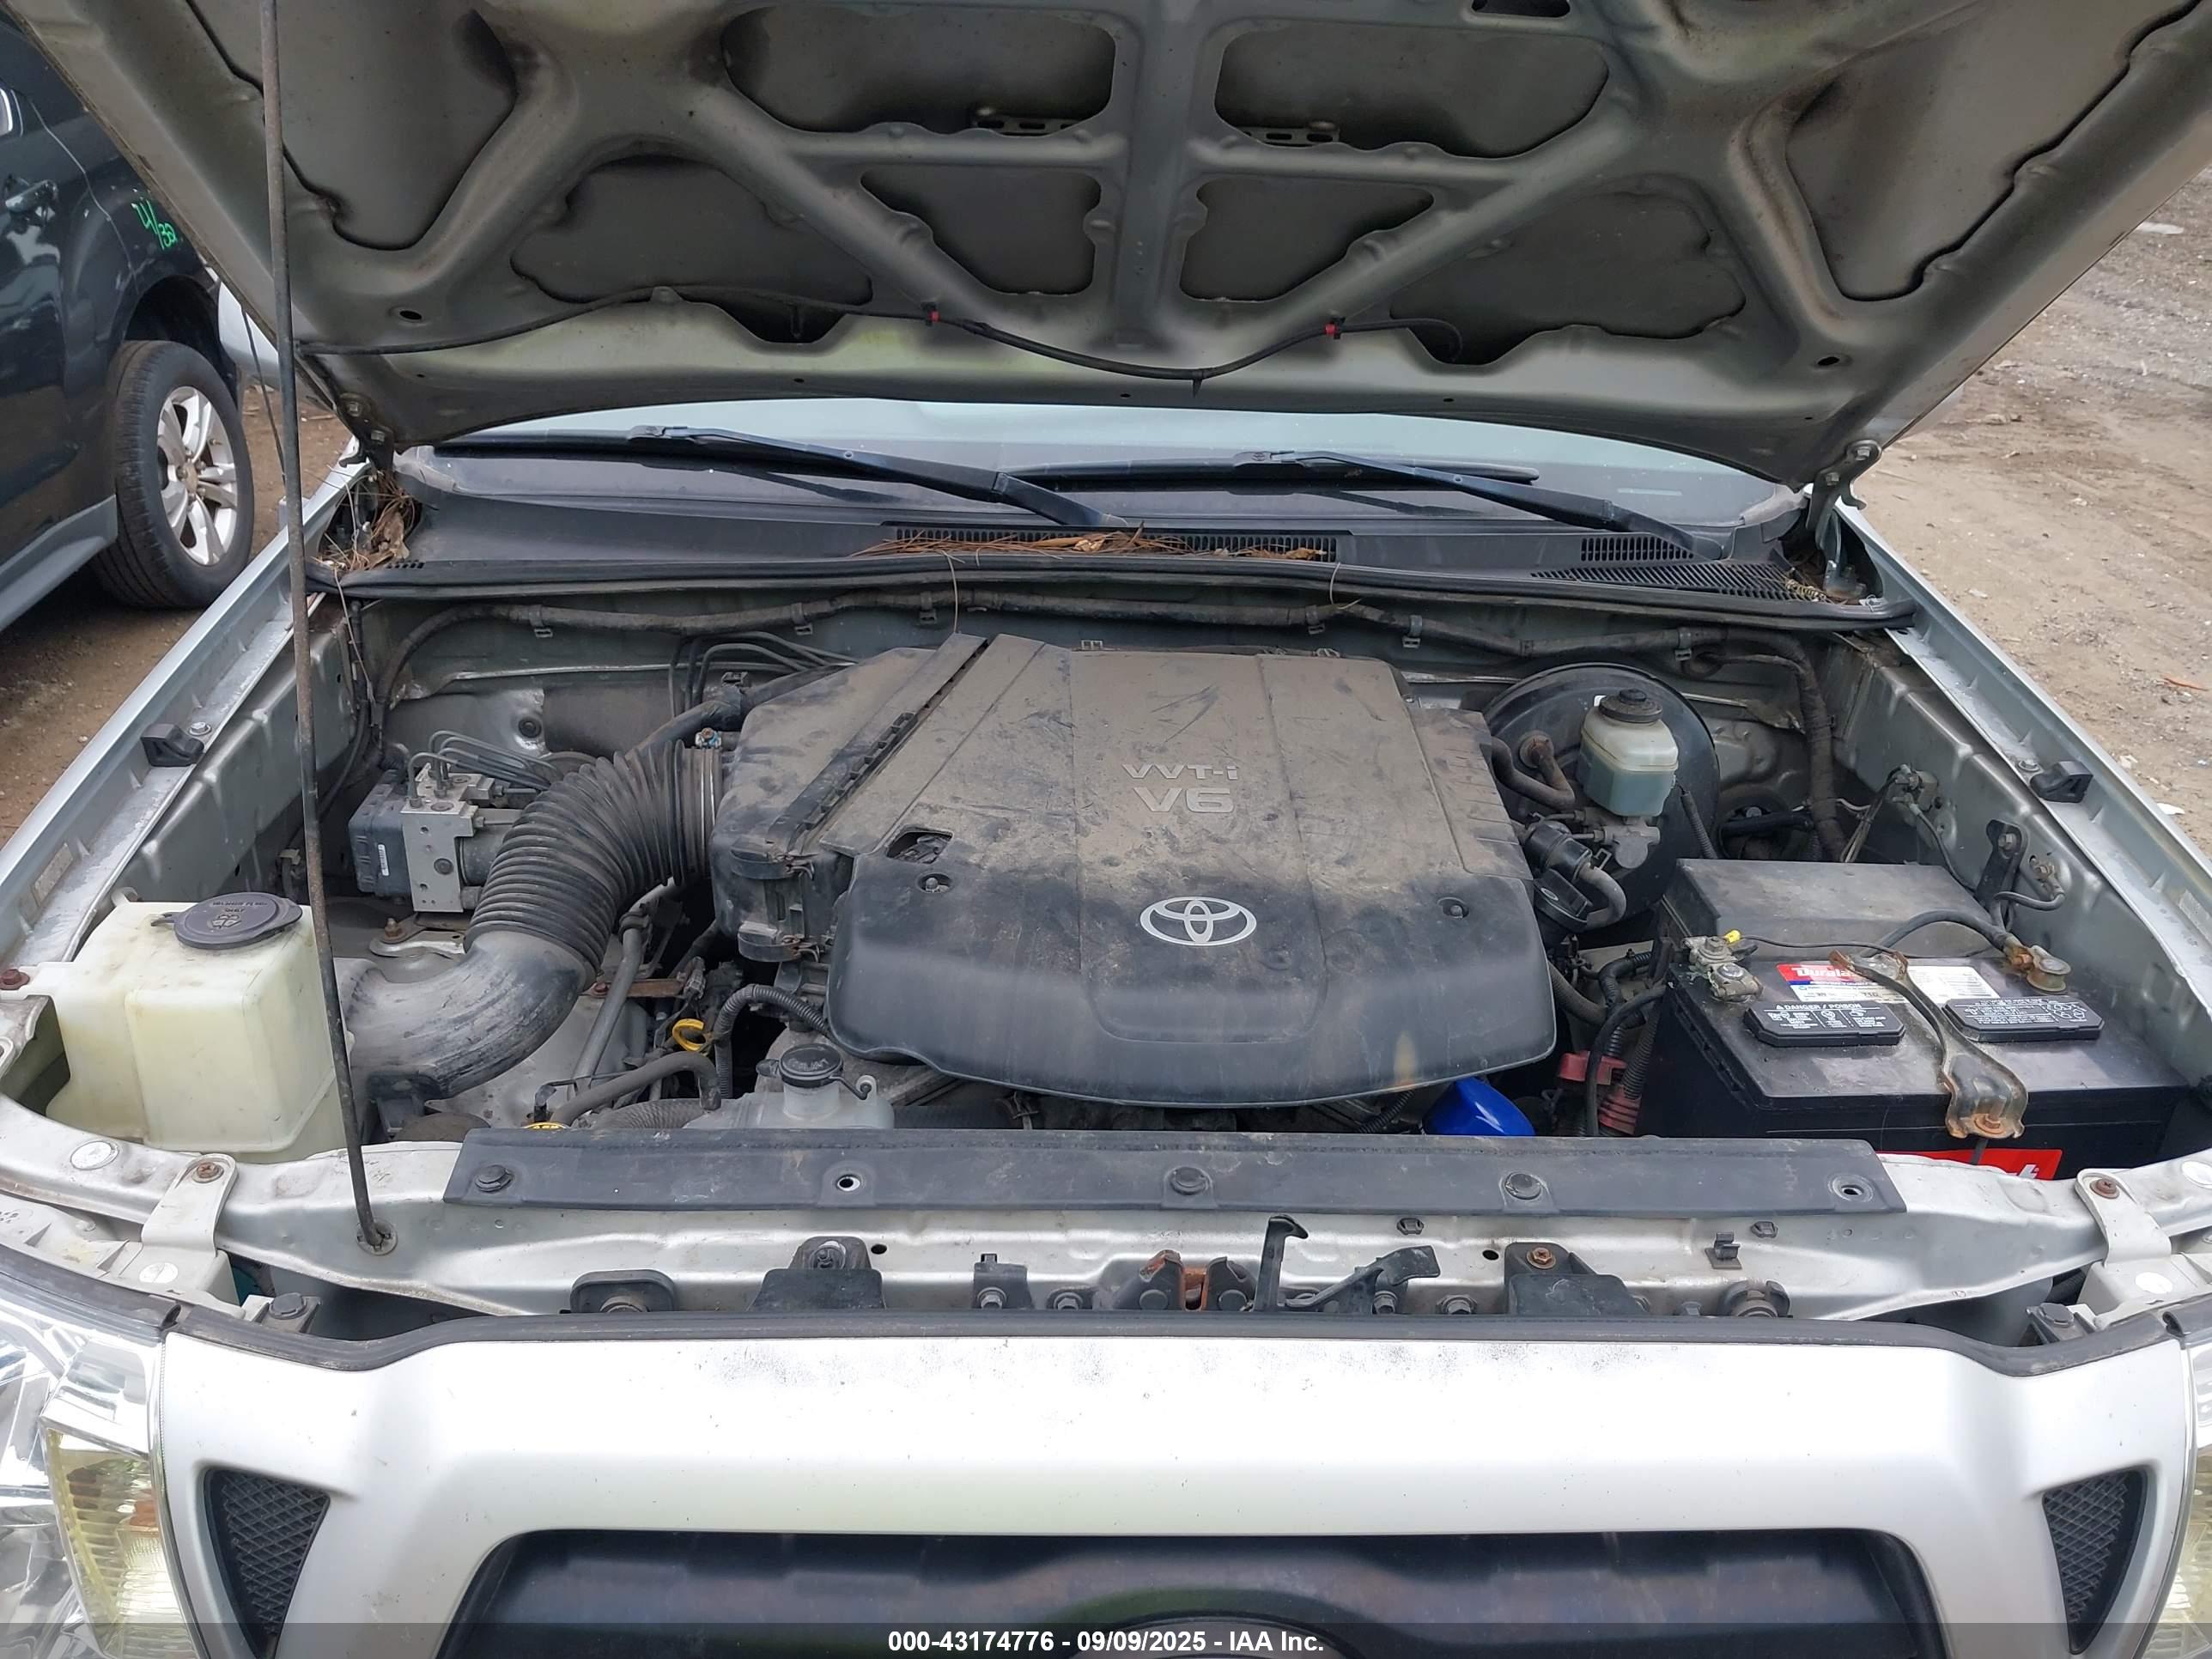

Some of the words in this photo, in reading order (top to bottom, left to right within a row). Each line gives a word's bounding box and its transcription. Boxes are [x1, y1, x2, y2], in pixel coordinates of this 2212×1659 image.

[1121, 763, 1239, 781] VVT-i
[1133, 787, 1236, 813] V6
[1791, 967, 1856, 977] Durala
